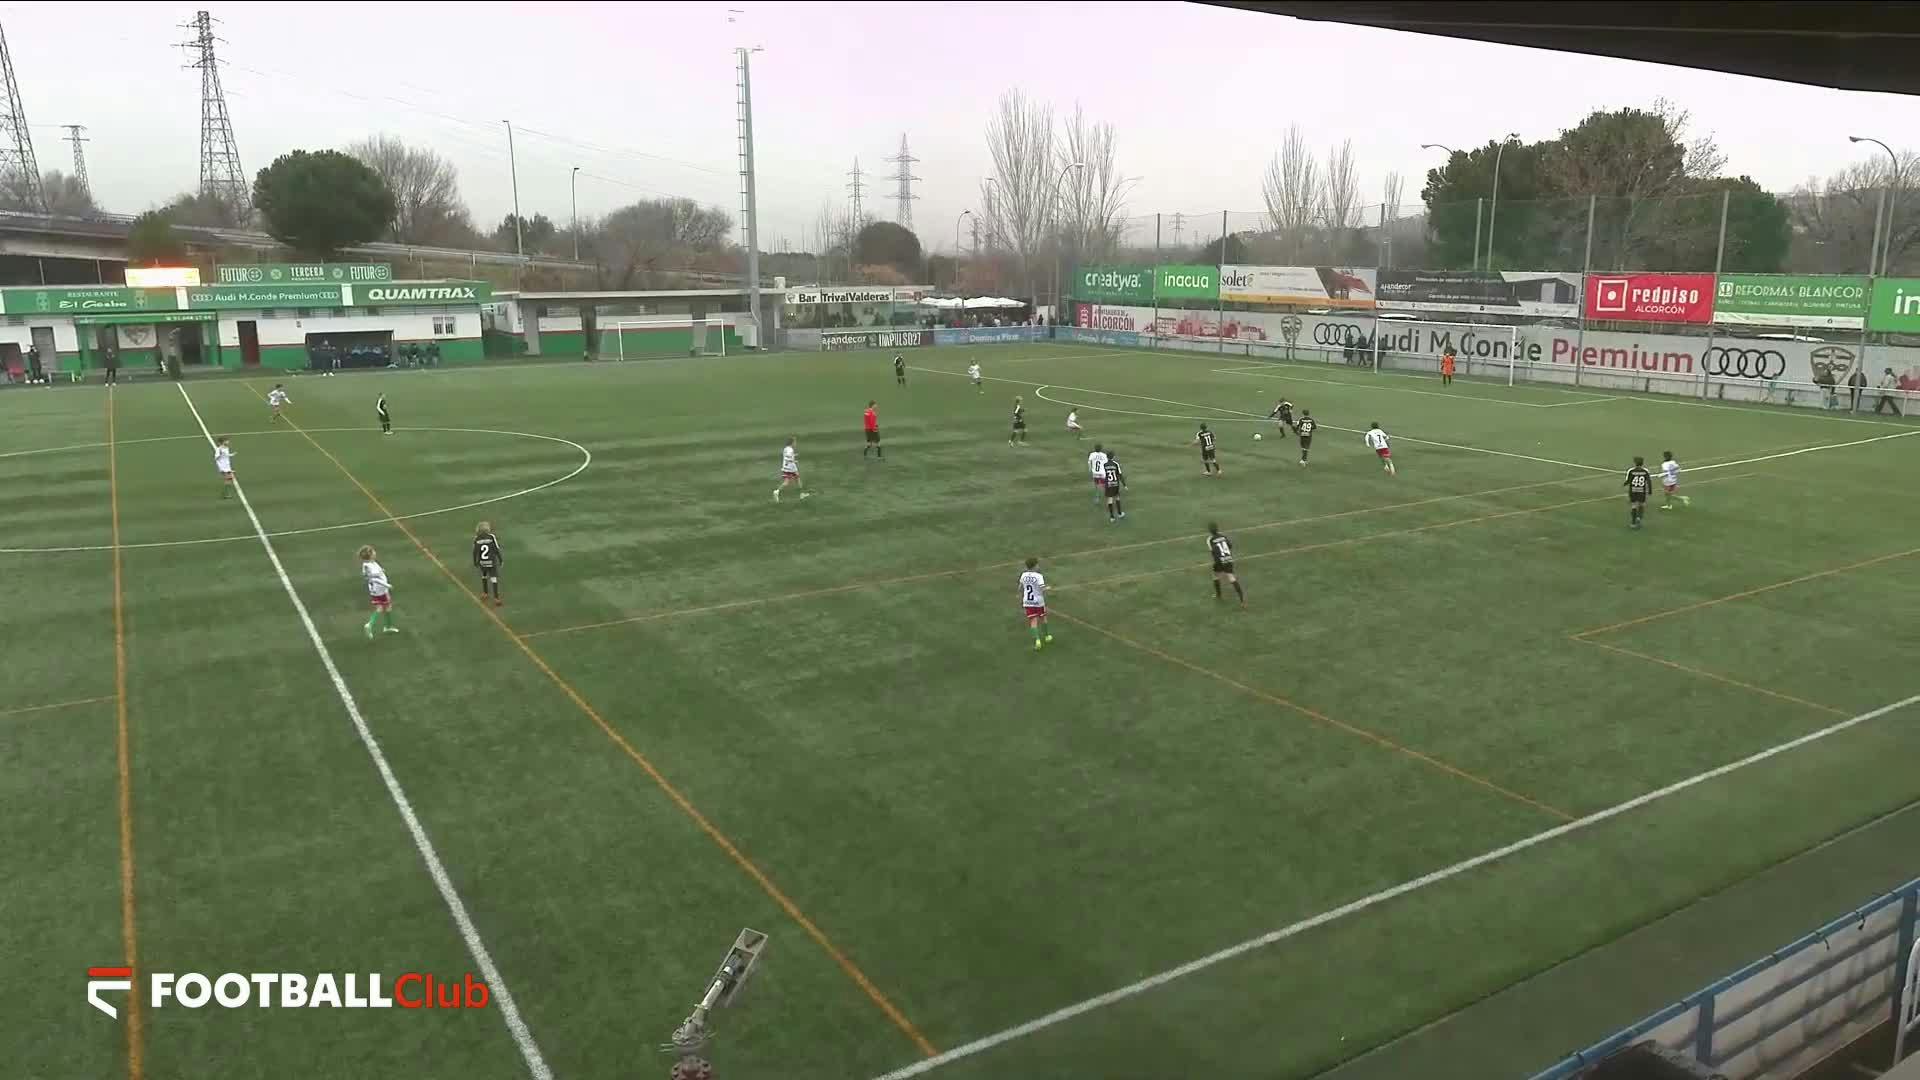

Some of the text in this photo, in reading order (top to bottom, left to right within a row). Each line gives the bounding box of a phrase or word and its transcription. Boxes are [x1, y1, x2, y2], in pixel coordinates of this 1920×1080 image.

[1164, 271, 1210, 289] inacua
[214, 293, 237, 301] Audi
[279, 291, 319, 301] Premium
[368, 287, 477, 301] QUAMTRAX
[798, 293, 817, 303] Bar
[822, 291, 890, 303] TrivalValderas
[1632, 285, 1699, 305] redpiso
[1735, 285, 1863, 299] REFORMAS BLANCOR
[1634, 303, 1685, 315] ALCORCÓN
[878, 332, 921, 347] IMPULSO27
[1368, 326, 1420, 354] Audi
[1551, 337, 1694, 373] Premium
[1300, 422, 1311, 432] 49
[1204, 435, 1213, 446] 11
[1107, 469, 1118, 482] 31
[1631, 475, 1645, 487] 48
[480, 544, 489, 560] 2
[1216, 541, 1231, 557] 14
[1026, 584, 1035, 601] 2
